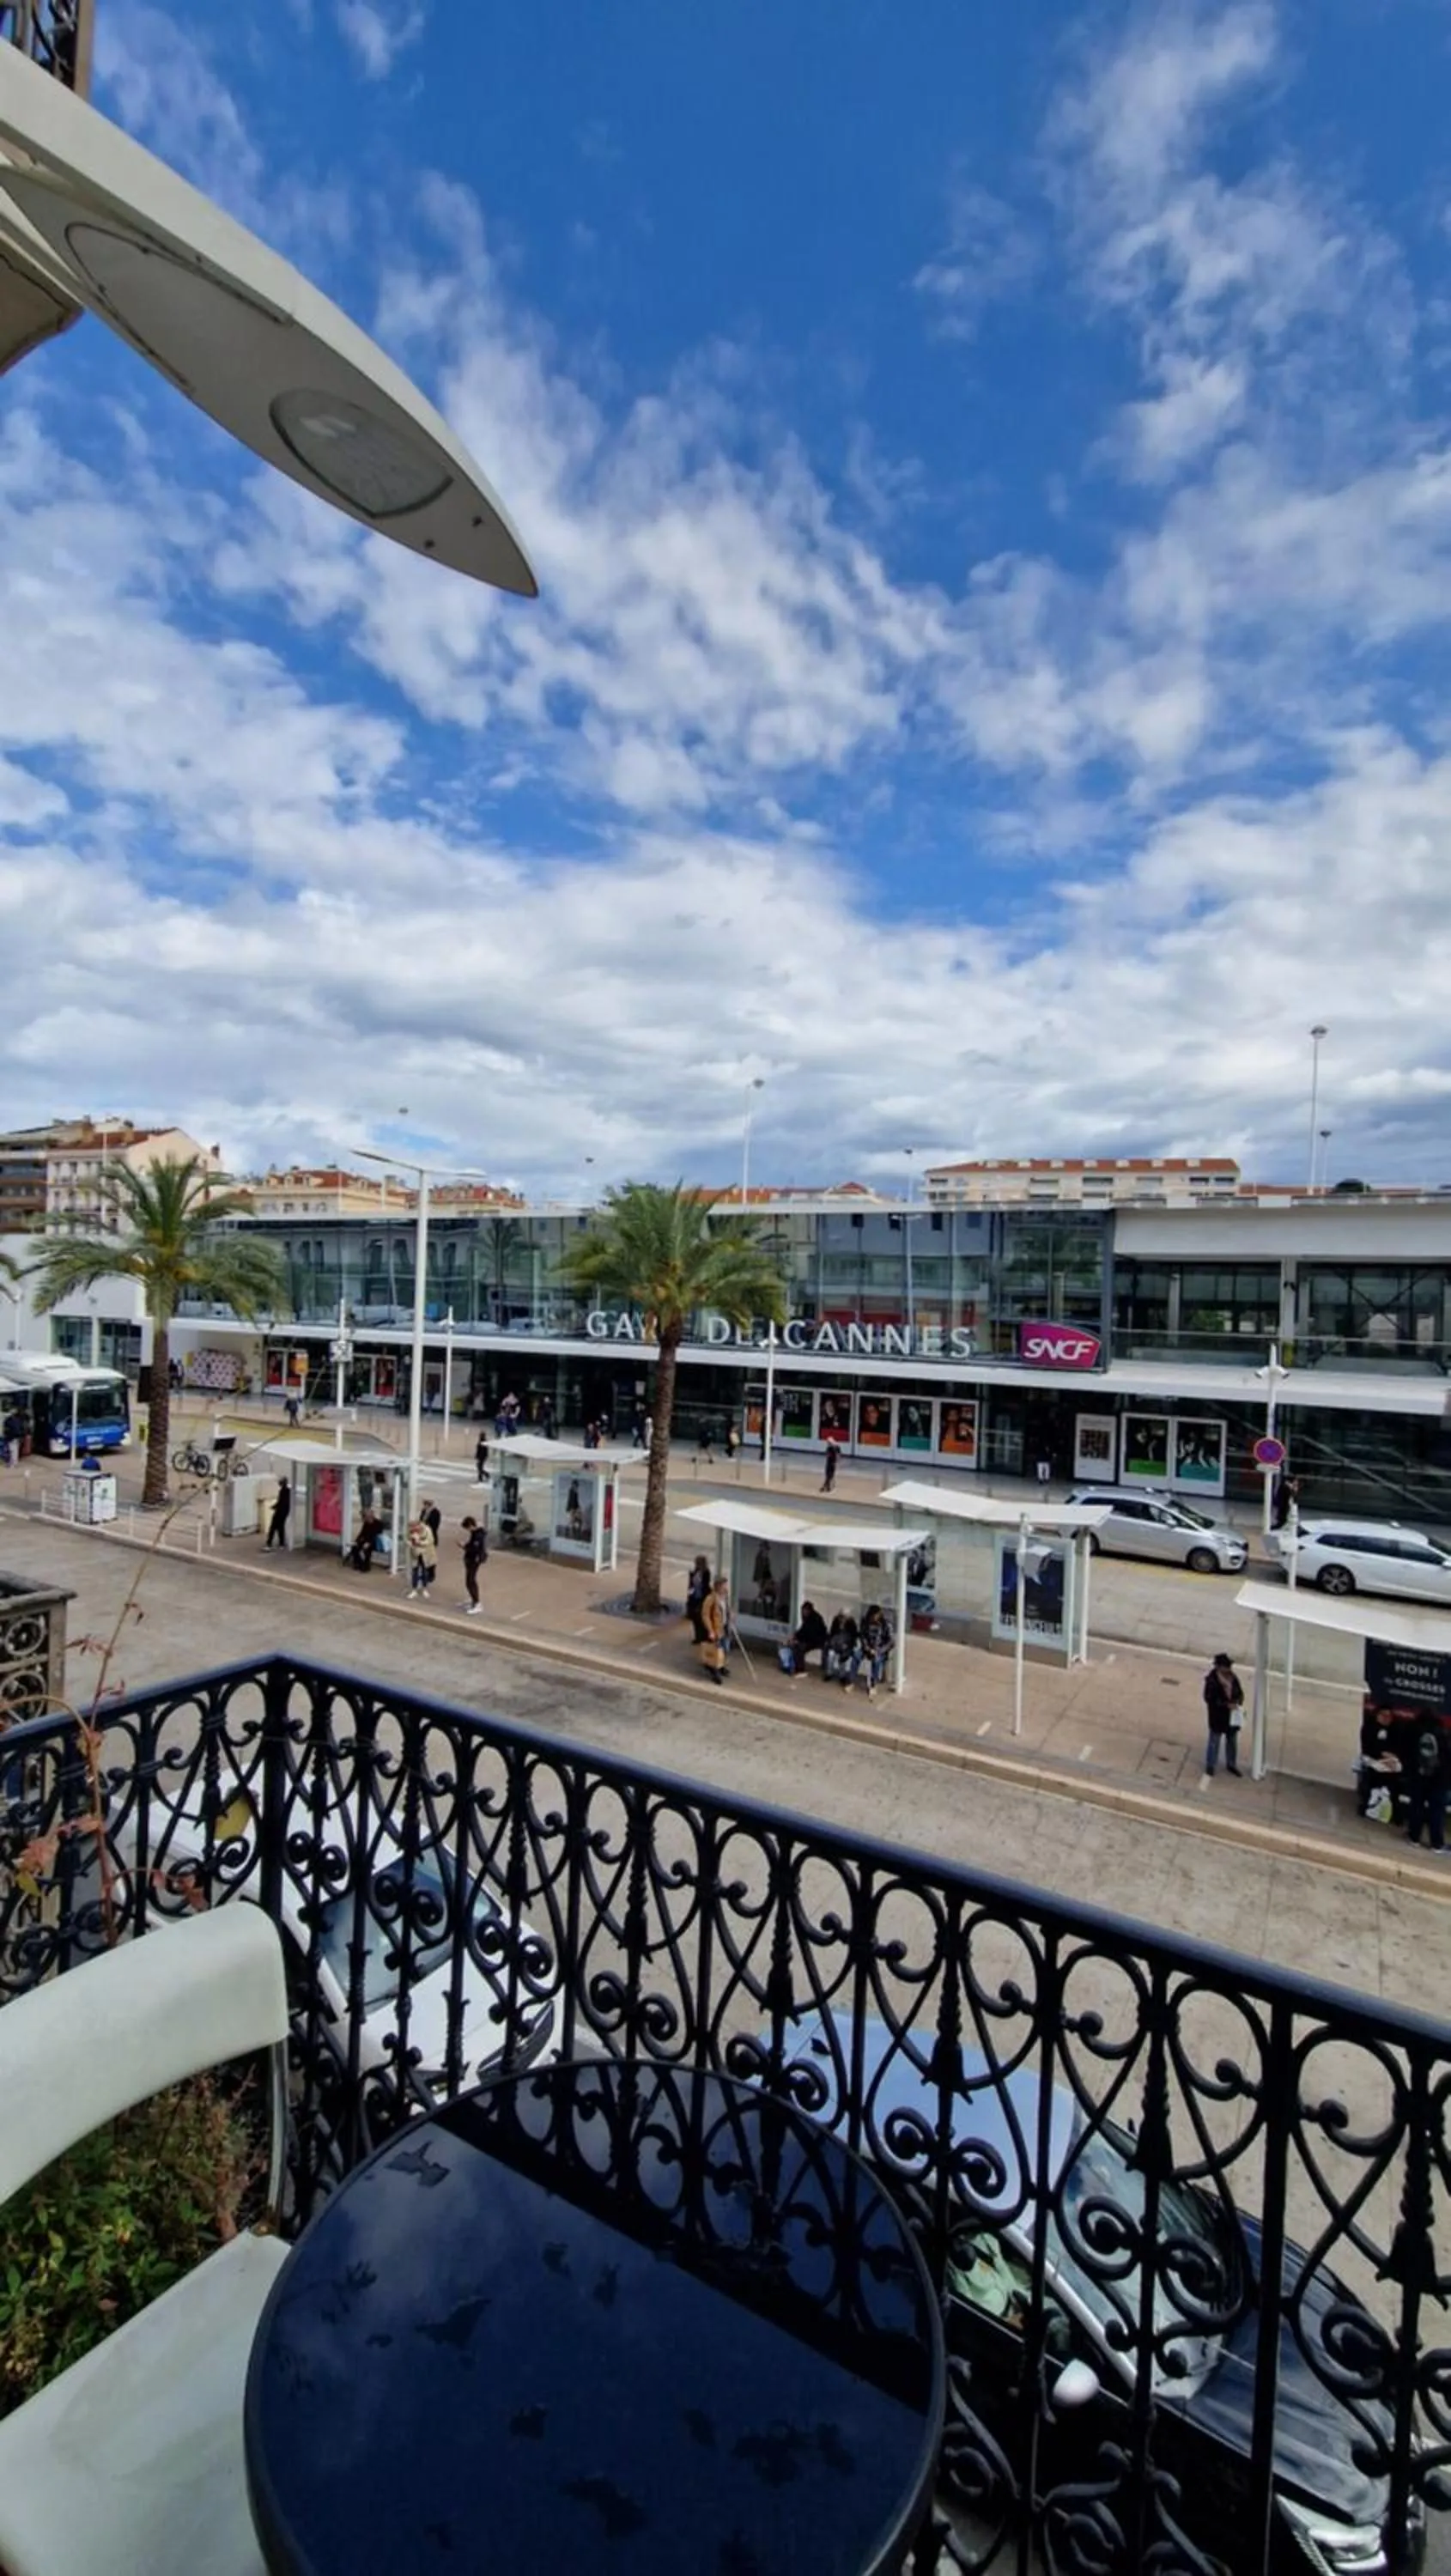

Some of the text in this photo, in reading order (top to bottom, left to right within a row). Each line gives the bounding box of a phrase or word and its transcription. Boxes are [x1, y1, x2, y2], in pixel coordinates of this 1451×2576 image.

[586, 1311, 689, 1346] GA
[784, 1320, 970, 1358] CANNES
[1024, 1338, 1095, 1360] SNCF
